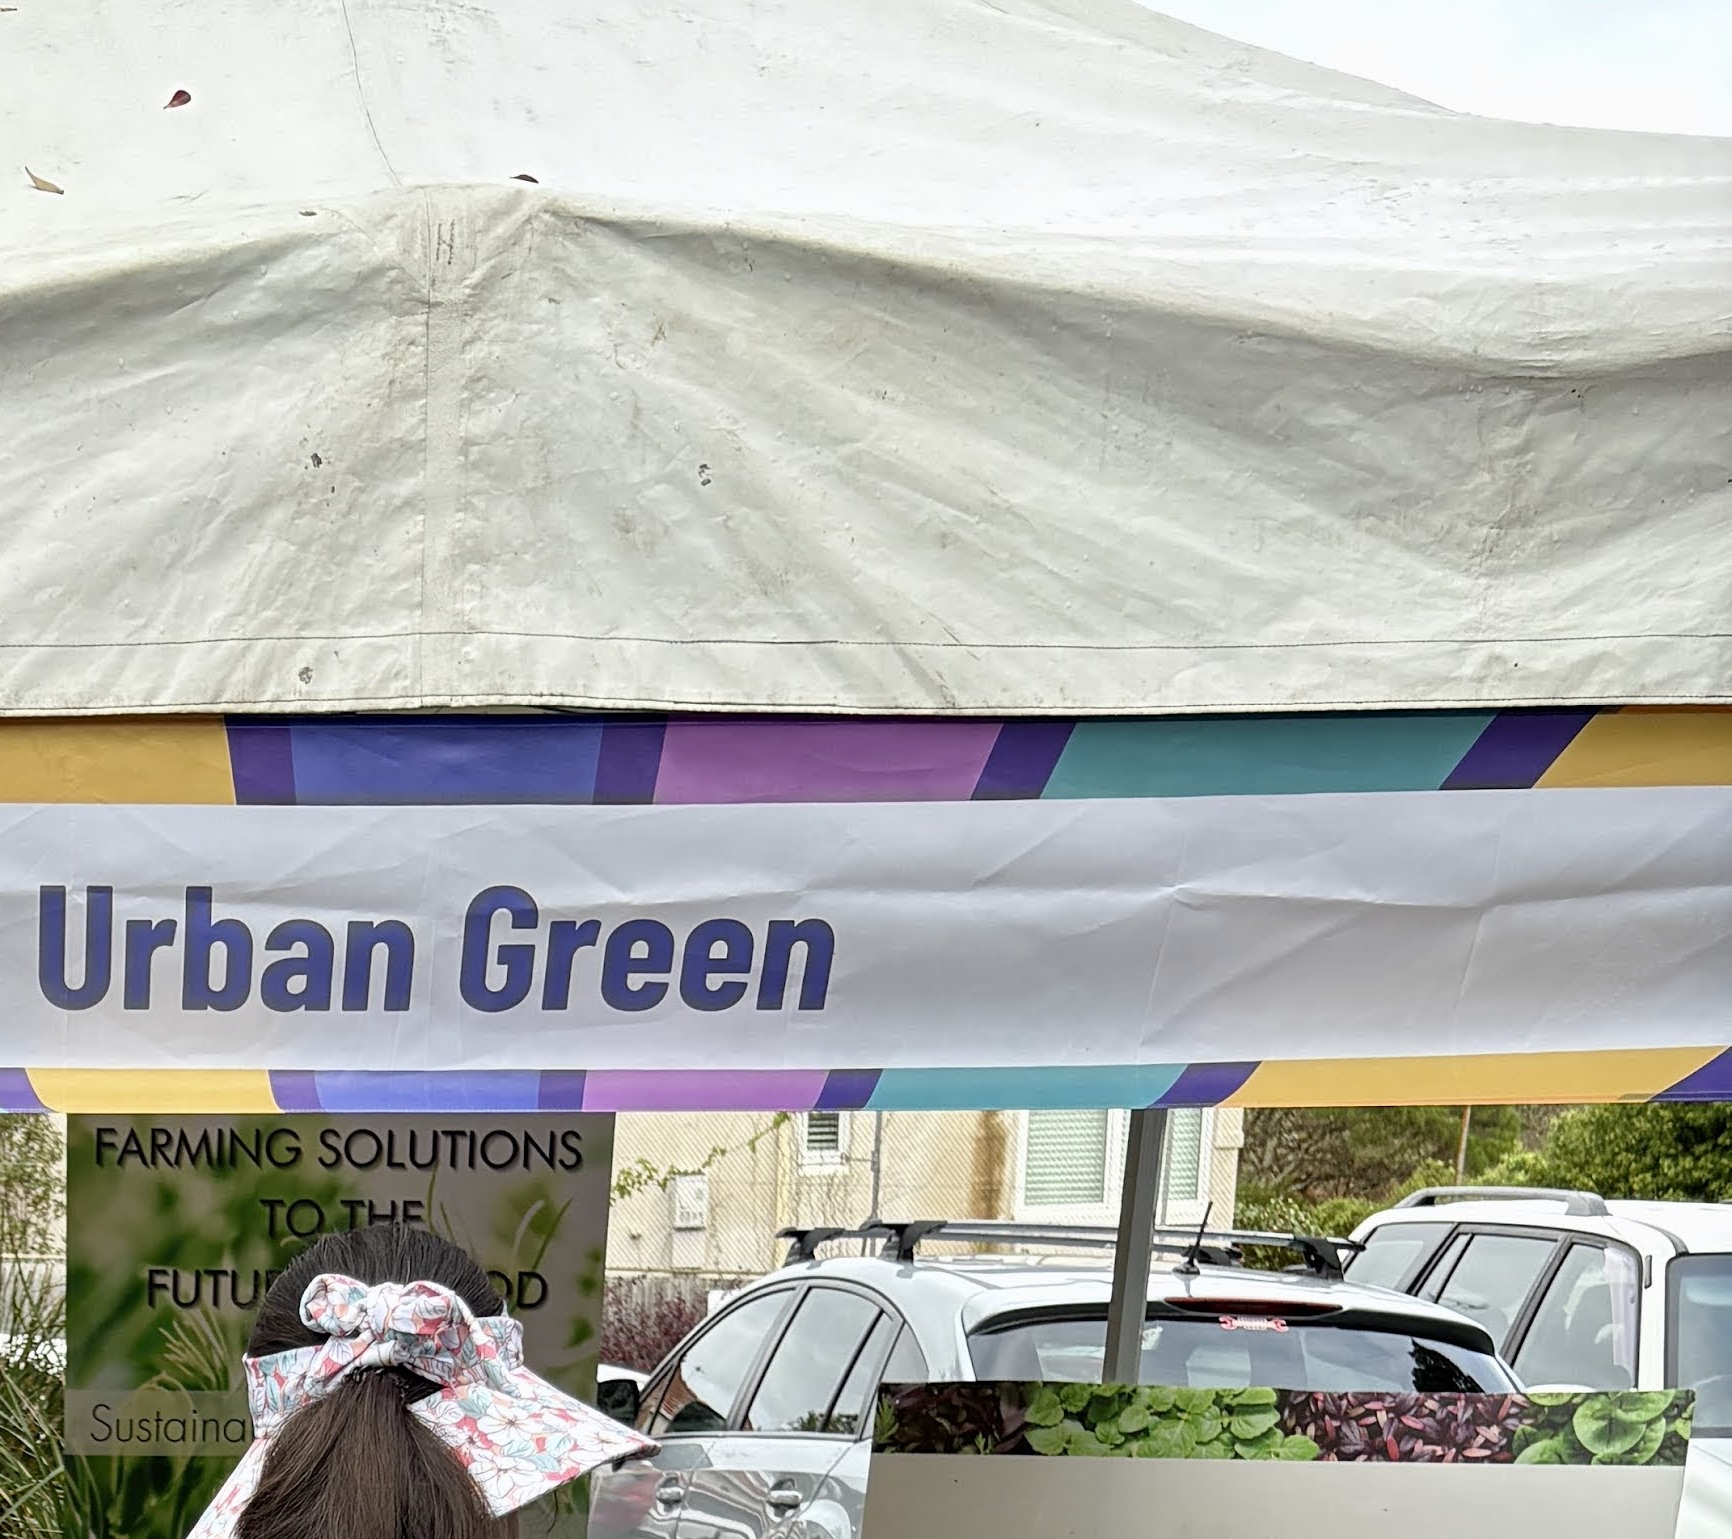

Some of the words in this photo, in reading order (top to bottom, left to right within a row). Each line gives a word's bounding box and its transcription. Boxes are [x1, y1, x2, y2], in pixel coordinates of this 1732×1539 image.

[38, 885, 415, 1011] Urban
[459, 885, 836, 1011] Green
[95, 1128, 303, 1169] FARMING
[318, 1129, 584, 1171] SOLUTIONS
[260, 1199, 325, 1238] TO
[340, 1199, 426, 1231] THE
[148, 1270, 282, 1309] FUTU
[90, 1404, 255, 1443] Sustaina
